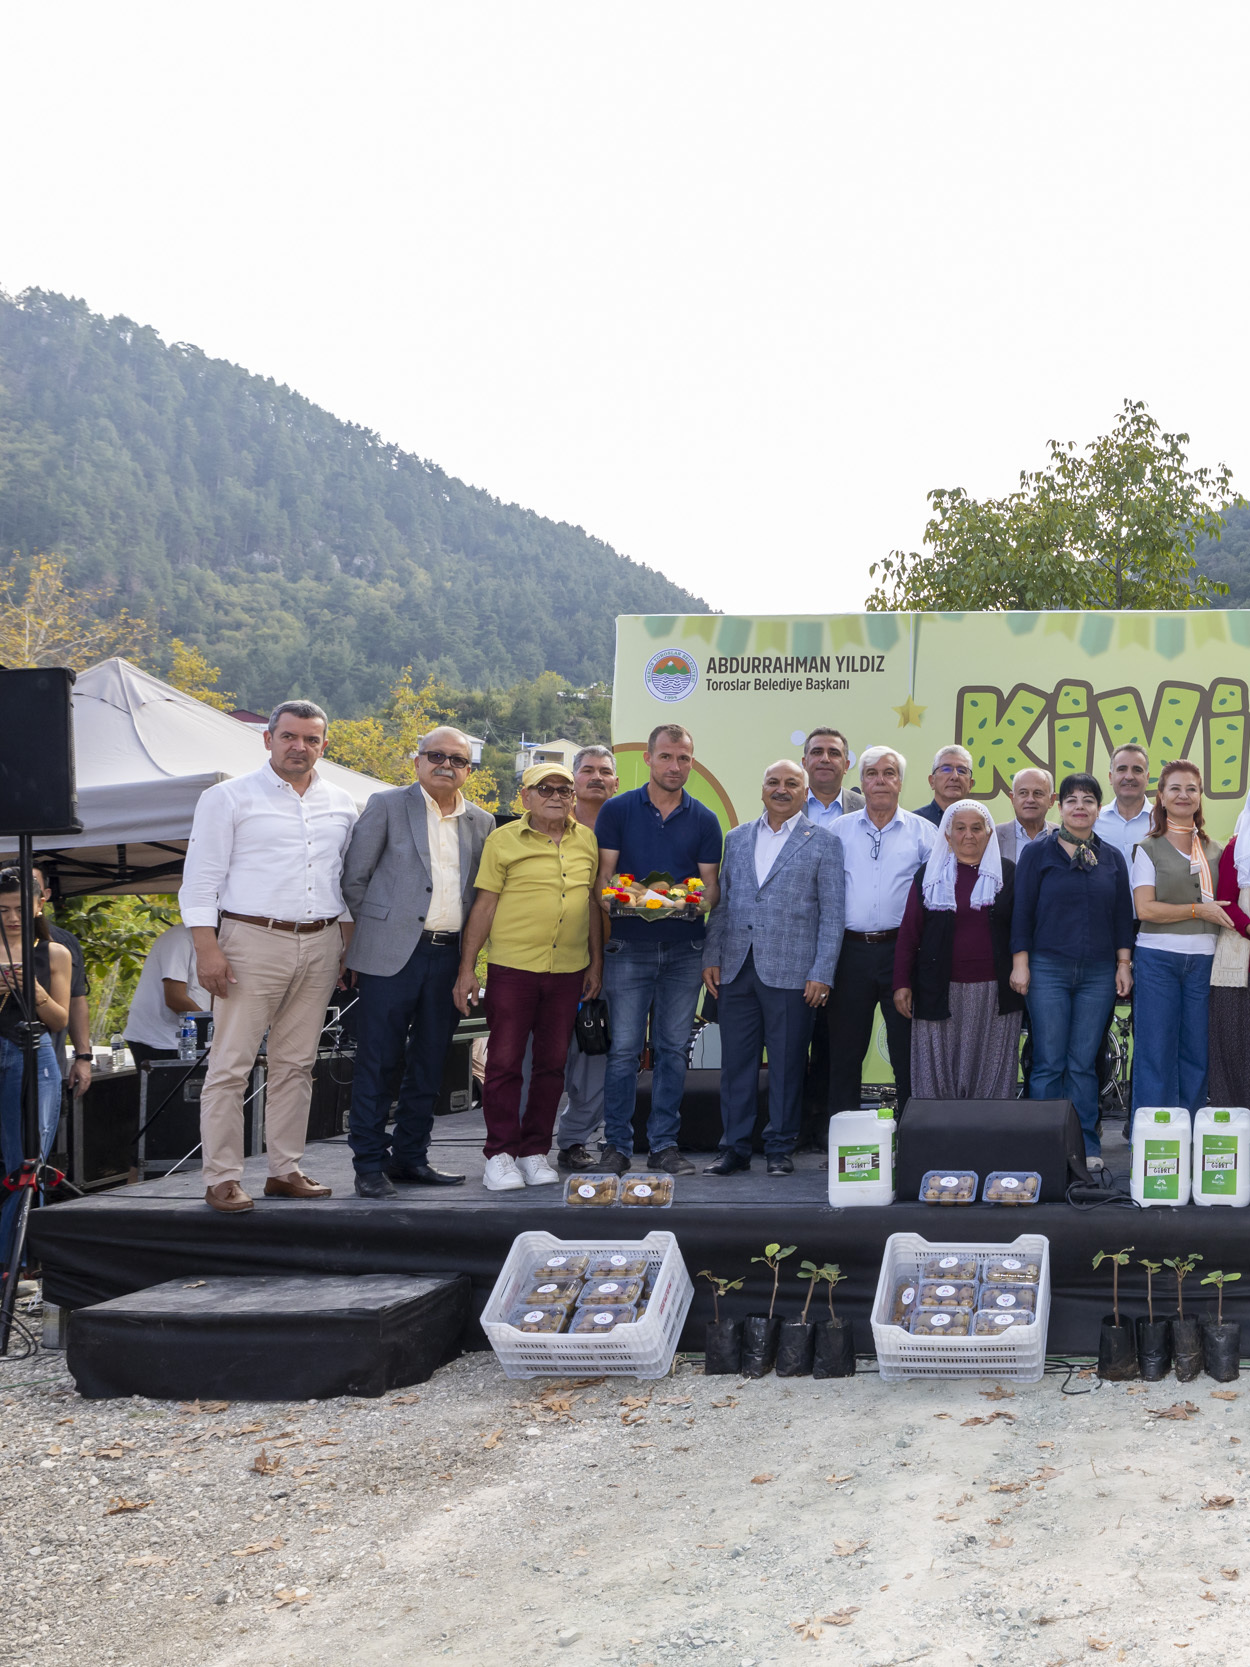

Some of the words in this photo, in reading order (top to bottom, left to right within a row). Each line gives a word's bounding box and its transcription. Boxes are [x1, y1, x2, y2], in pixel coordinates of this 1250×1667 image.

[706, 656, 830, 674] ABDURRAHMAN
[835, 655, 885, 672] YILDIZ
[706, 678, 751, 691] Toroslar
[754, 678, 802, 692] Belediye
[806, 677, 850, 692] Başkanı
